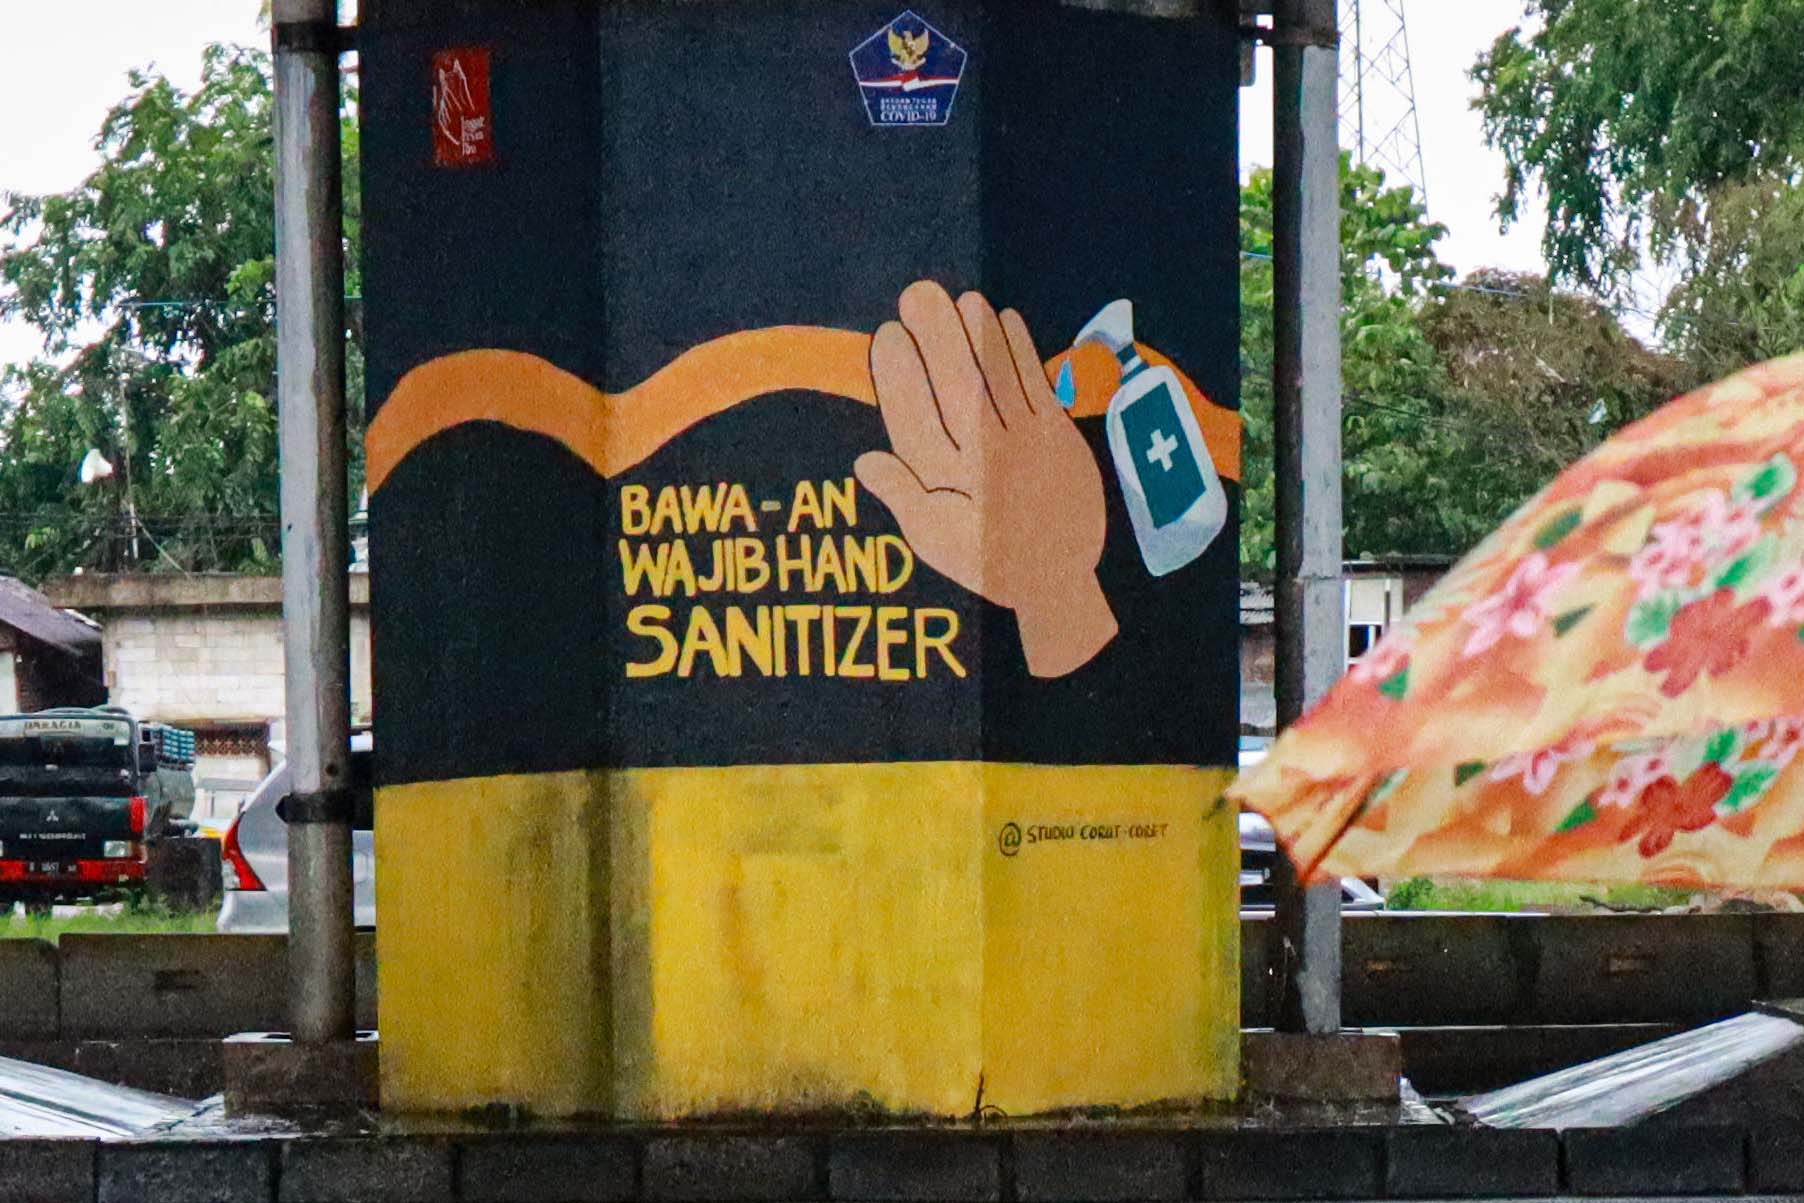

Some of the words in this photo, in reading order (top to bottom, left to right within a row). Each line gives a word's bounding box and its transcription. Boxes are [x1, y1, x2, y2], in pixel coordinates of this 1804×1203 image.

[880, 110, 937, 121] COVID-19
[619, 538, 771, 597] WAJIB
[776, 534, 914, 593] HAND
[626, 604, 967, 680] SANITIZER
